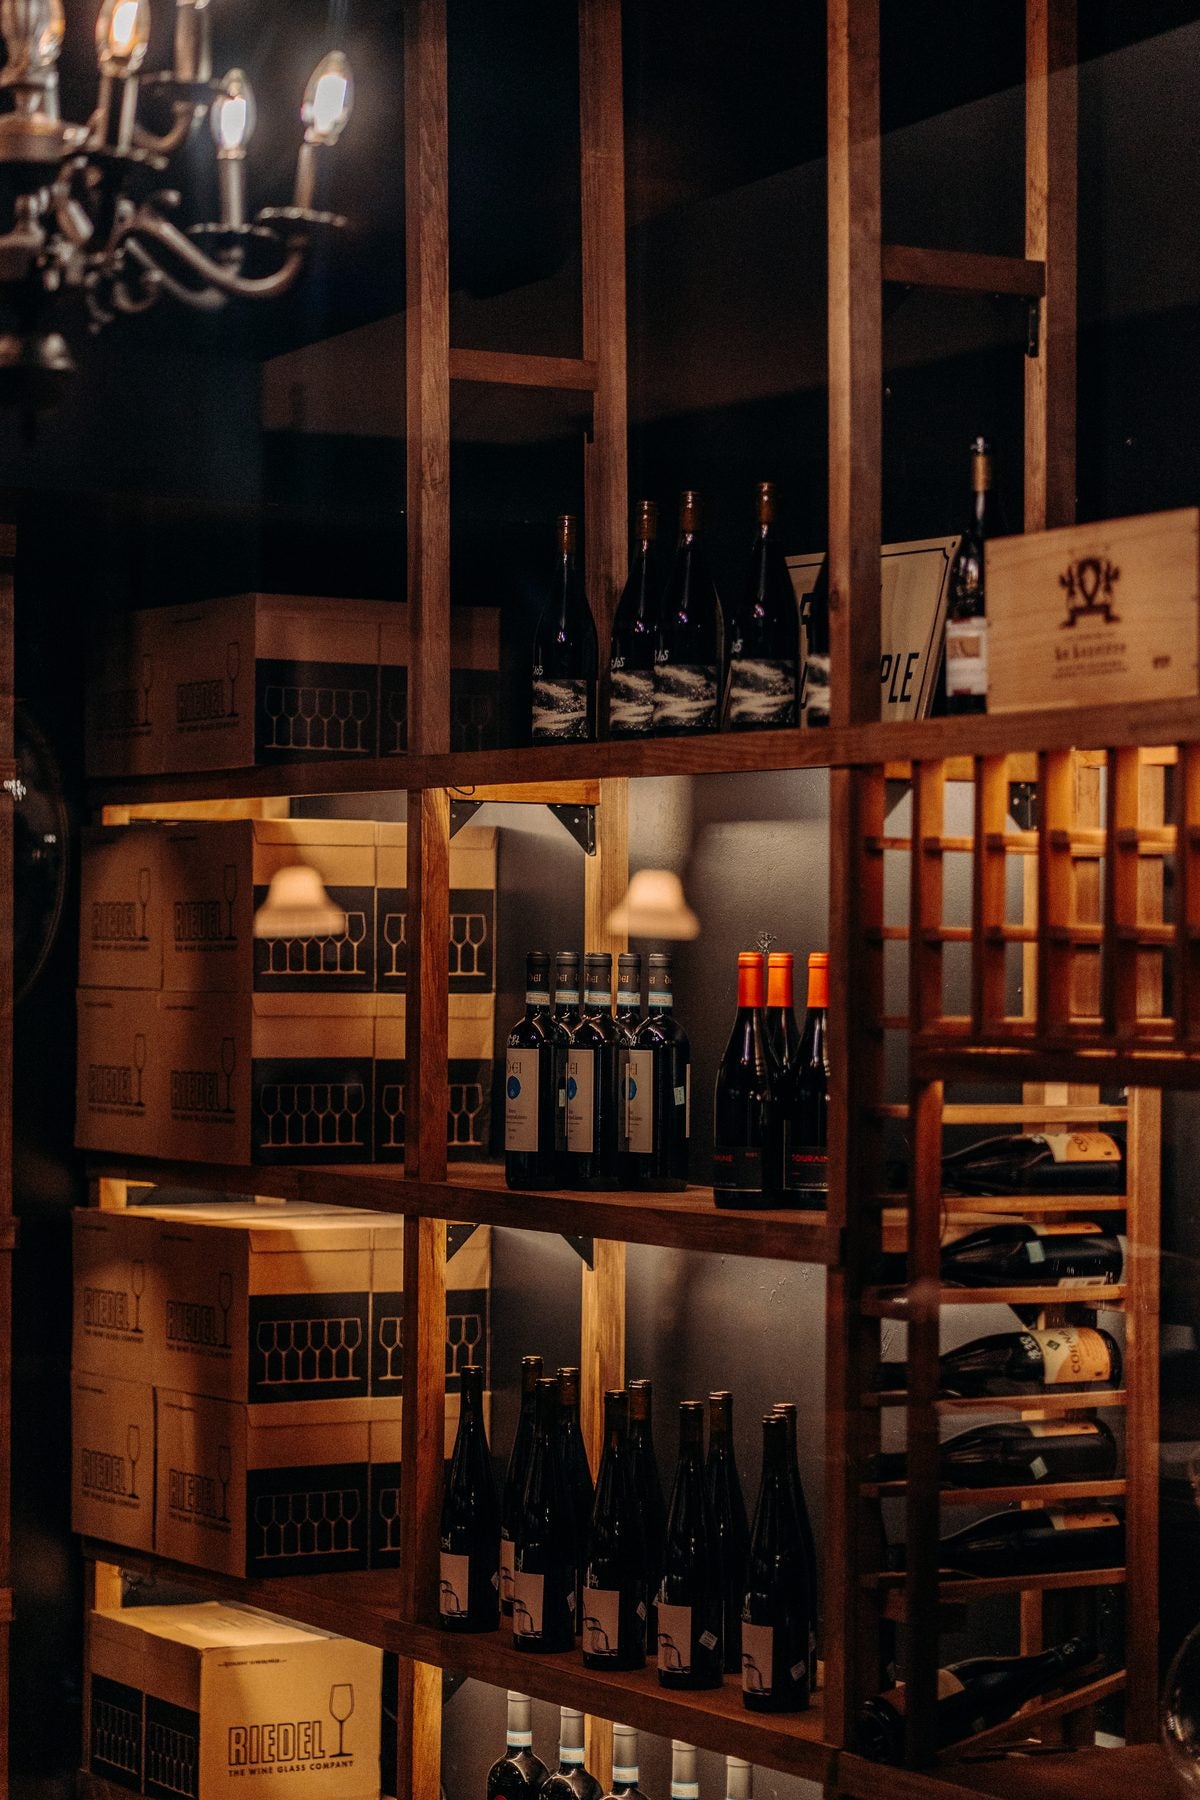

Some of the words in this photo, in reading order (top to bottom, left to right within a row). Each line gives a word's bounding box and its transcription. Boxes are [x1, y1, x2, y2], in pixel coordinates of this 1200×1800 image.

[228, 1720, 326, 1767] RIEDEL
[228, 1769, 246, 1778] THE
[248, 1766, 273, 1776] WINE
[277, 1764, 306, 1774] GLASS
[309, 1760, 354, 1771] COMPANY
